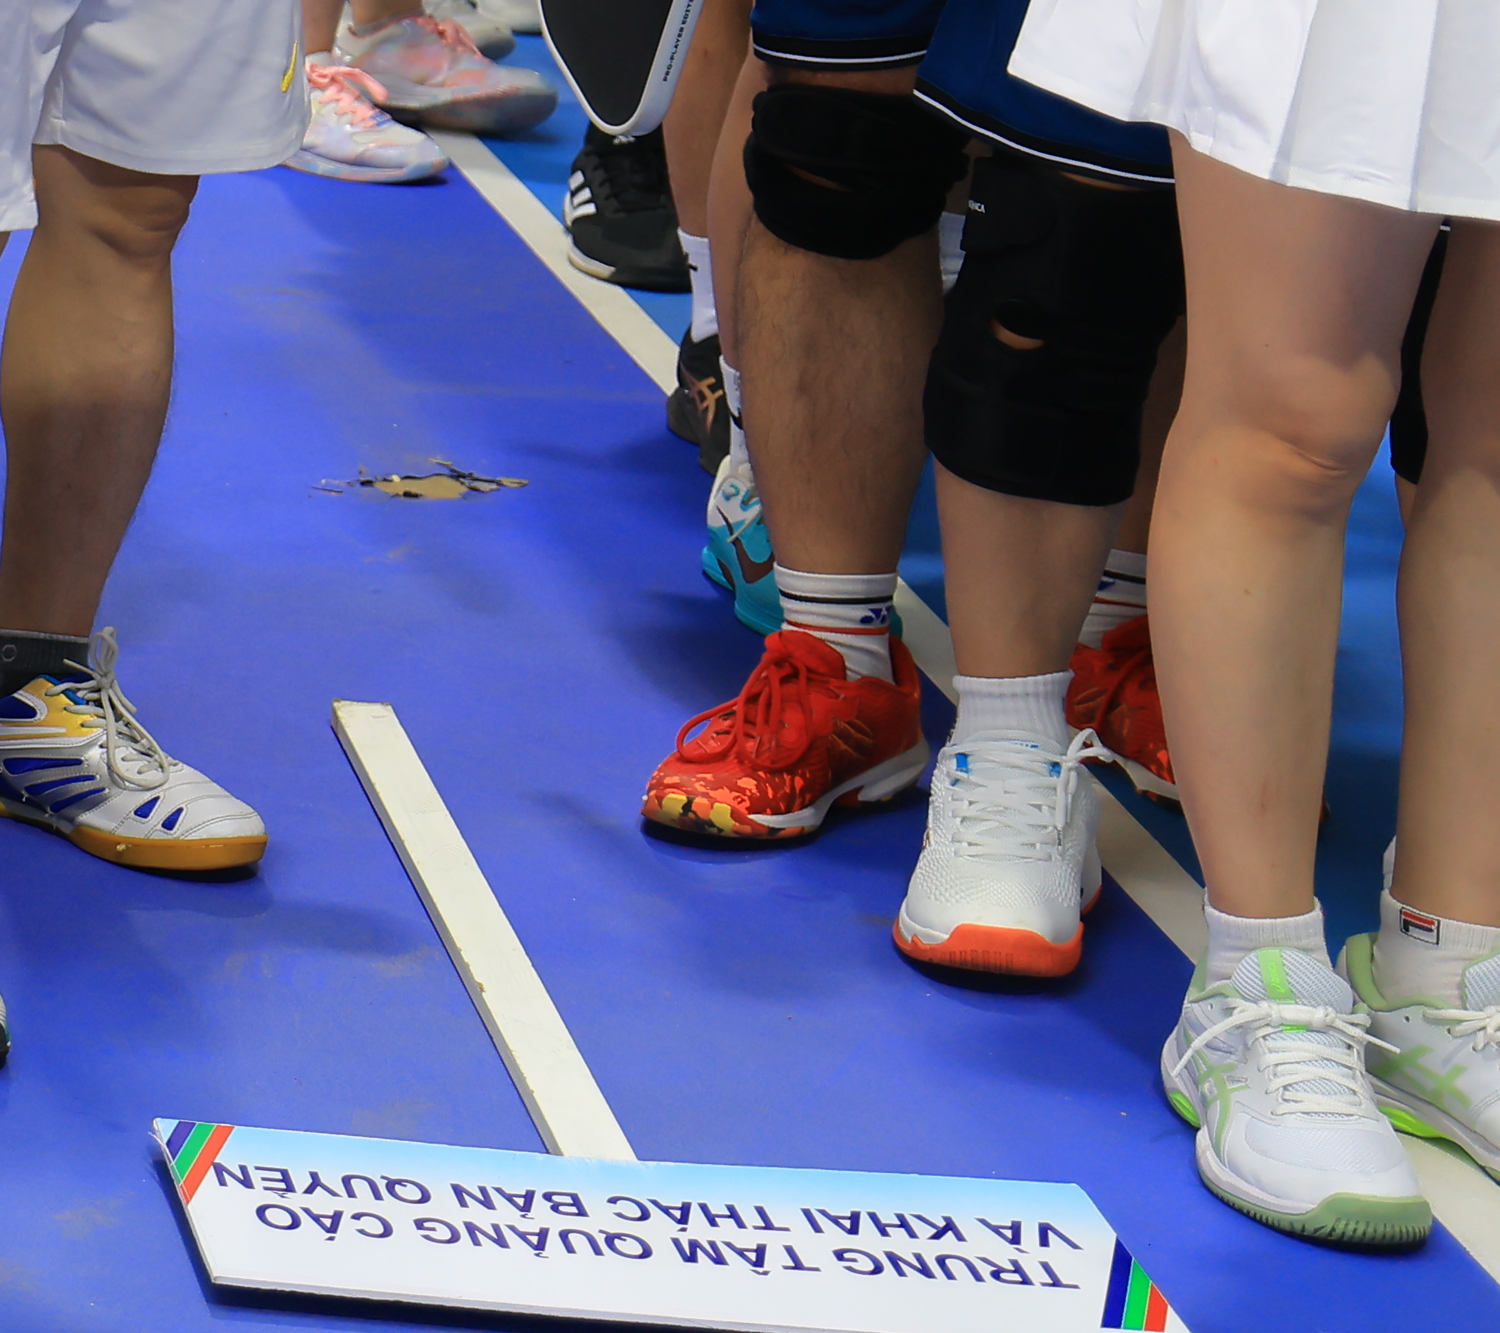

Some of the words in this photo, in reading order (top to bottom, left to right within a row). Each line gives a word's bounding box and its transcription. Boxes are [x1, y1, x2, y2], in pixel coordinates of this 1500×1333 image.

[212, 1162, 432, 1204] QUYỀN
[450, 1183, 589, 1220] BẢN
[255, 1203, 394, 1241] CÁO
[607, 1195, 791, 1232] THÁC
[800, 1208, 967, 1242] KHAI
[414, 1217, 653, 1259] QUẢNG
[976, 1217, 1084, 1253] VÀ
[671, 1237, 821, 1276] TÂM
[832, 1247, 1081, 1289] TRUNG
